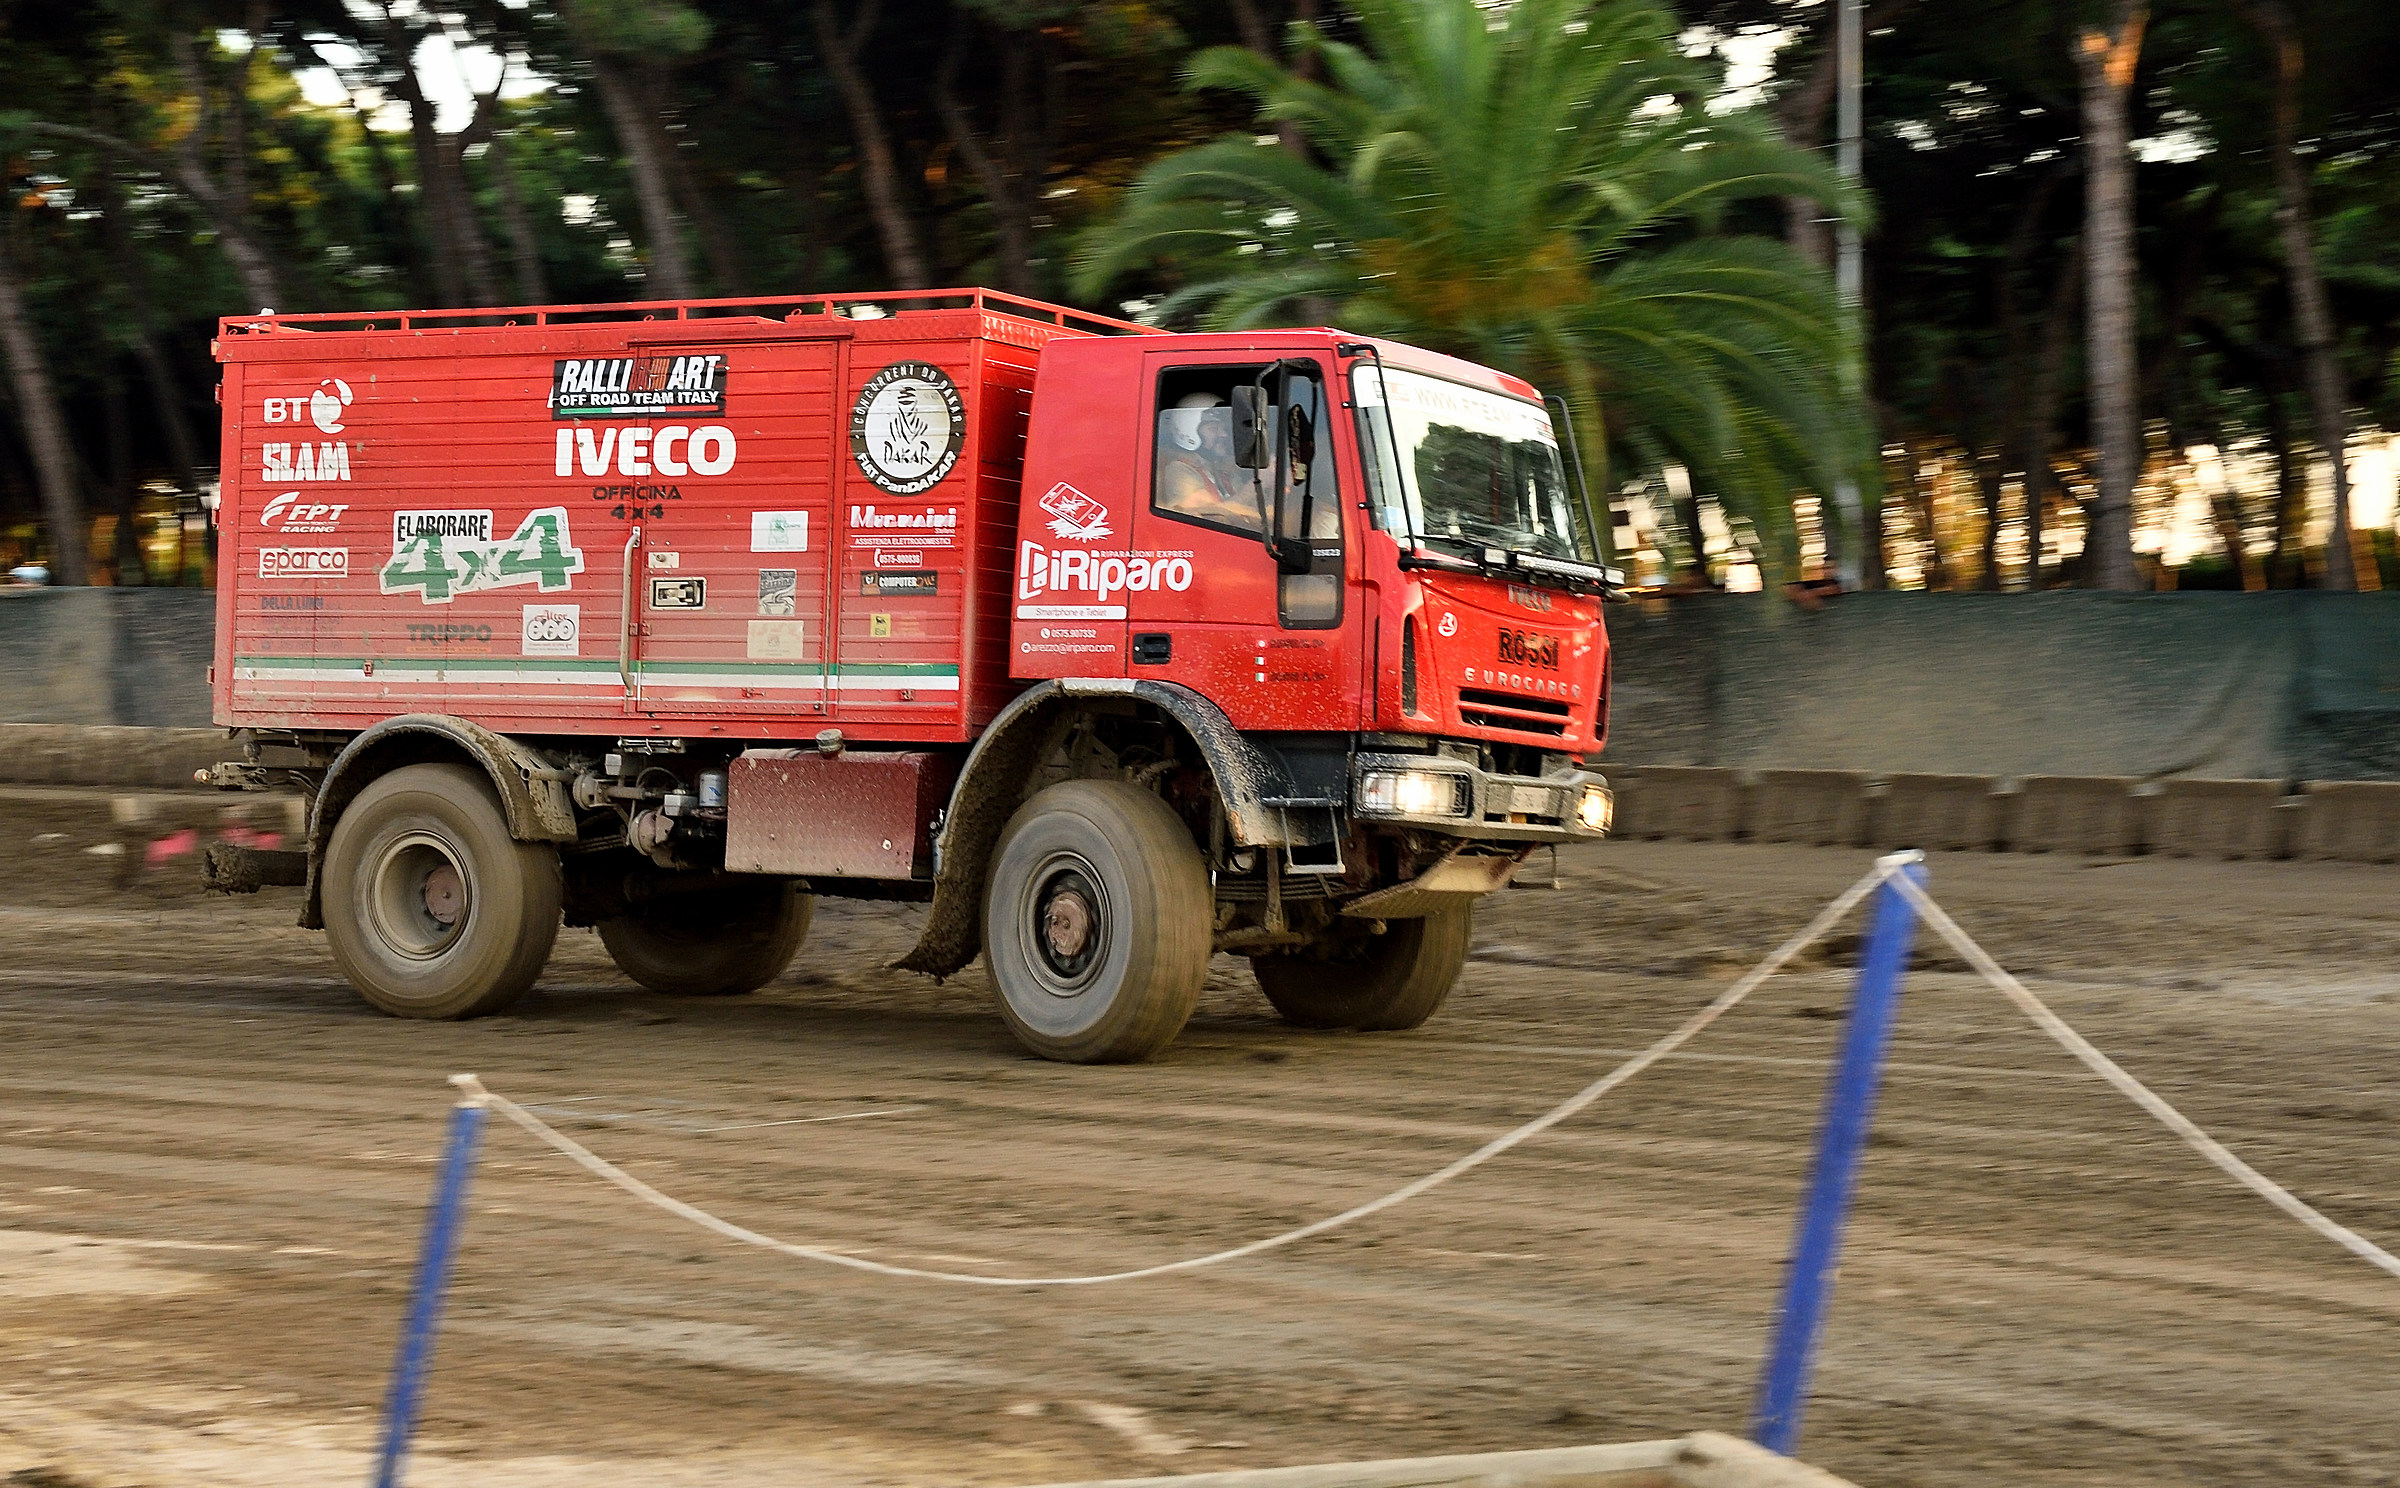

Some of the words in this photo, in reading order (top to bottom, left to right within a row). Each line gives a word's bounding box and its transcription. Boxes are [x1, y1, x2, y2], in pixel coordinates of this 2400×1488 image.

[560, 359, 633, 393] RALLI
[666, 355, 721, 390] ART
[560, 394, 587, 406] OFF
[591, 393, 630, 405] ROAD
[634, 391, 673, 405] TEAM
[678, 390, 719, 404] ITALY
[854, 364, 914, 425] CONCURRENT
[921, 366, 937, 382] DU
[938, 380, 963, 423] DAKAR
[264, 397, 309, 422] BT
[262, 442, 351, 481] SLAM
[555, 425, 737, 476] IVECO
[884, 441, 933, 465] DAKAR
[857, 452, 879, 479] FIAT
[593, 485, 682, 500] OFFICINA
[288, 505, 349, 520] FPT
[397, 513, 488, 541] ELABORARE
[263, 552, 346, 575] sparco
[383, 514, 576, 599] 4x4
[1100, 550, 1154, 558] RIPARAZIONI
[1156, 550, 1194, 558] EXPRESS
[1050, 550, 1193, 602] iRiparo
[407, 624, 492, 646] TRIPPO
[1498, 626, 1558, 671] ROSSI
